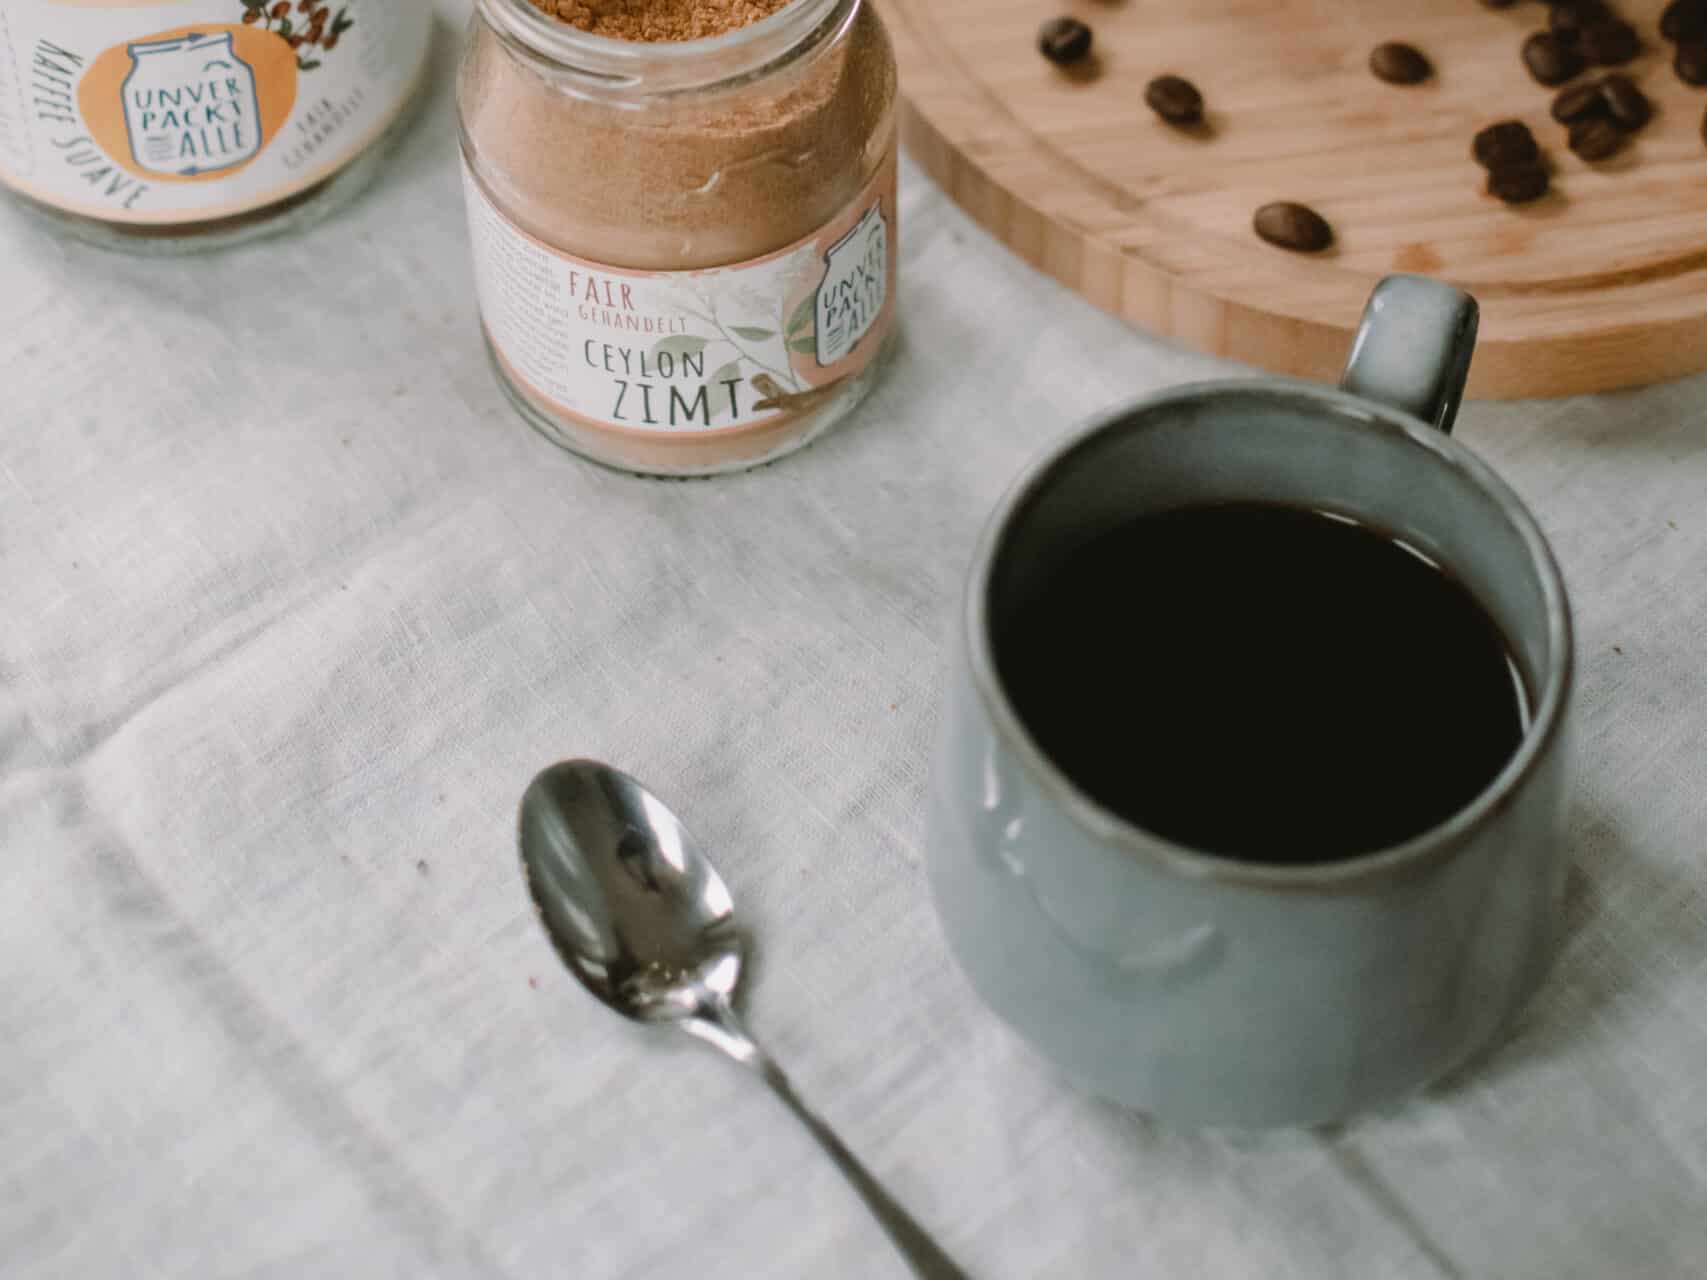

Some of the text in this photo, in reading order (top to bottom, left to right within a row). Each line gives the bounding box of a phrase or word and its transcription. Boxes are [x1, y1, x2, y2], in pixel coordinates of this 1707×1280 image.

[134, 77, 242, 109] UNVER
[32, 38, 148, 209] KAFFEE SUAVE
[179, 122, 243, 158] ALLE
[569, 271, 634, 311] FAIR
[578, 304, 687, 336] GEHANDELT
[584, 339, 704, 379] CEYLON
[613, 377, 744, 427] ZIMT
